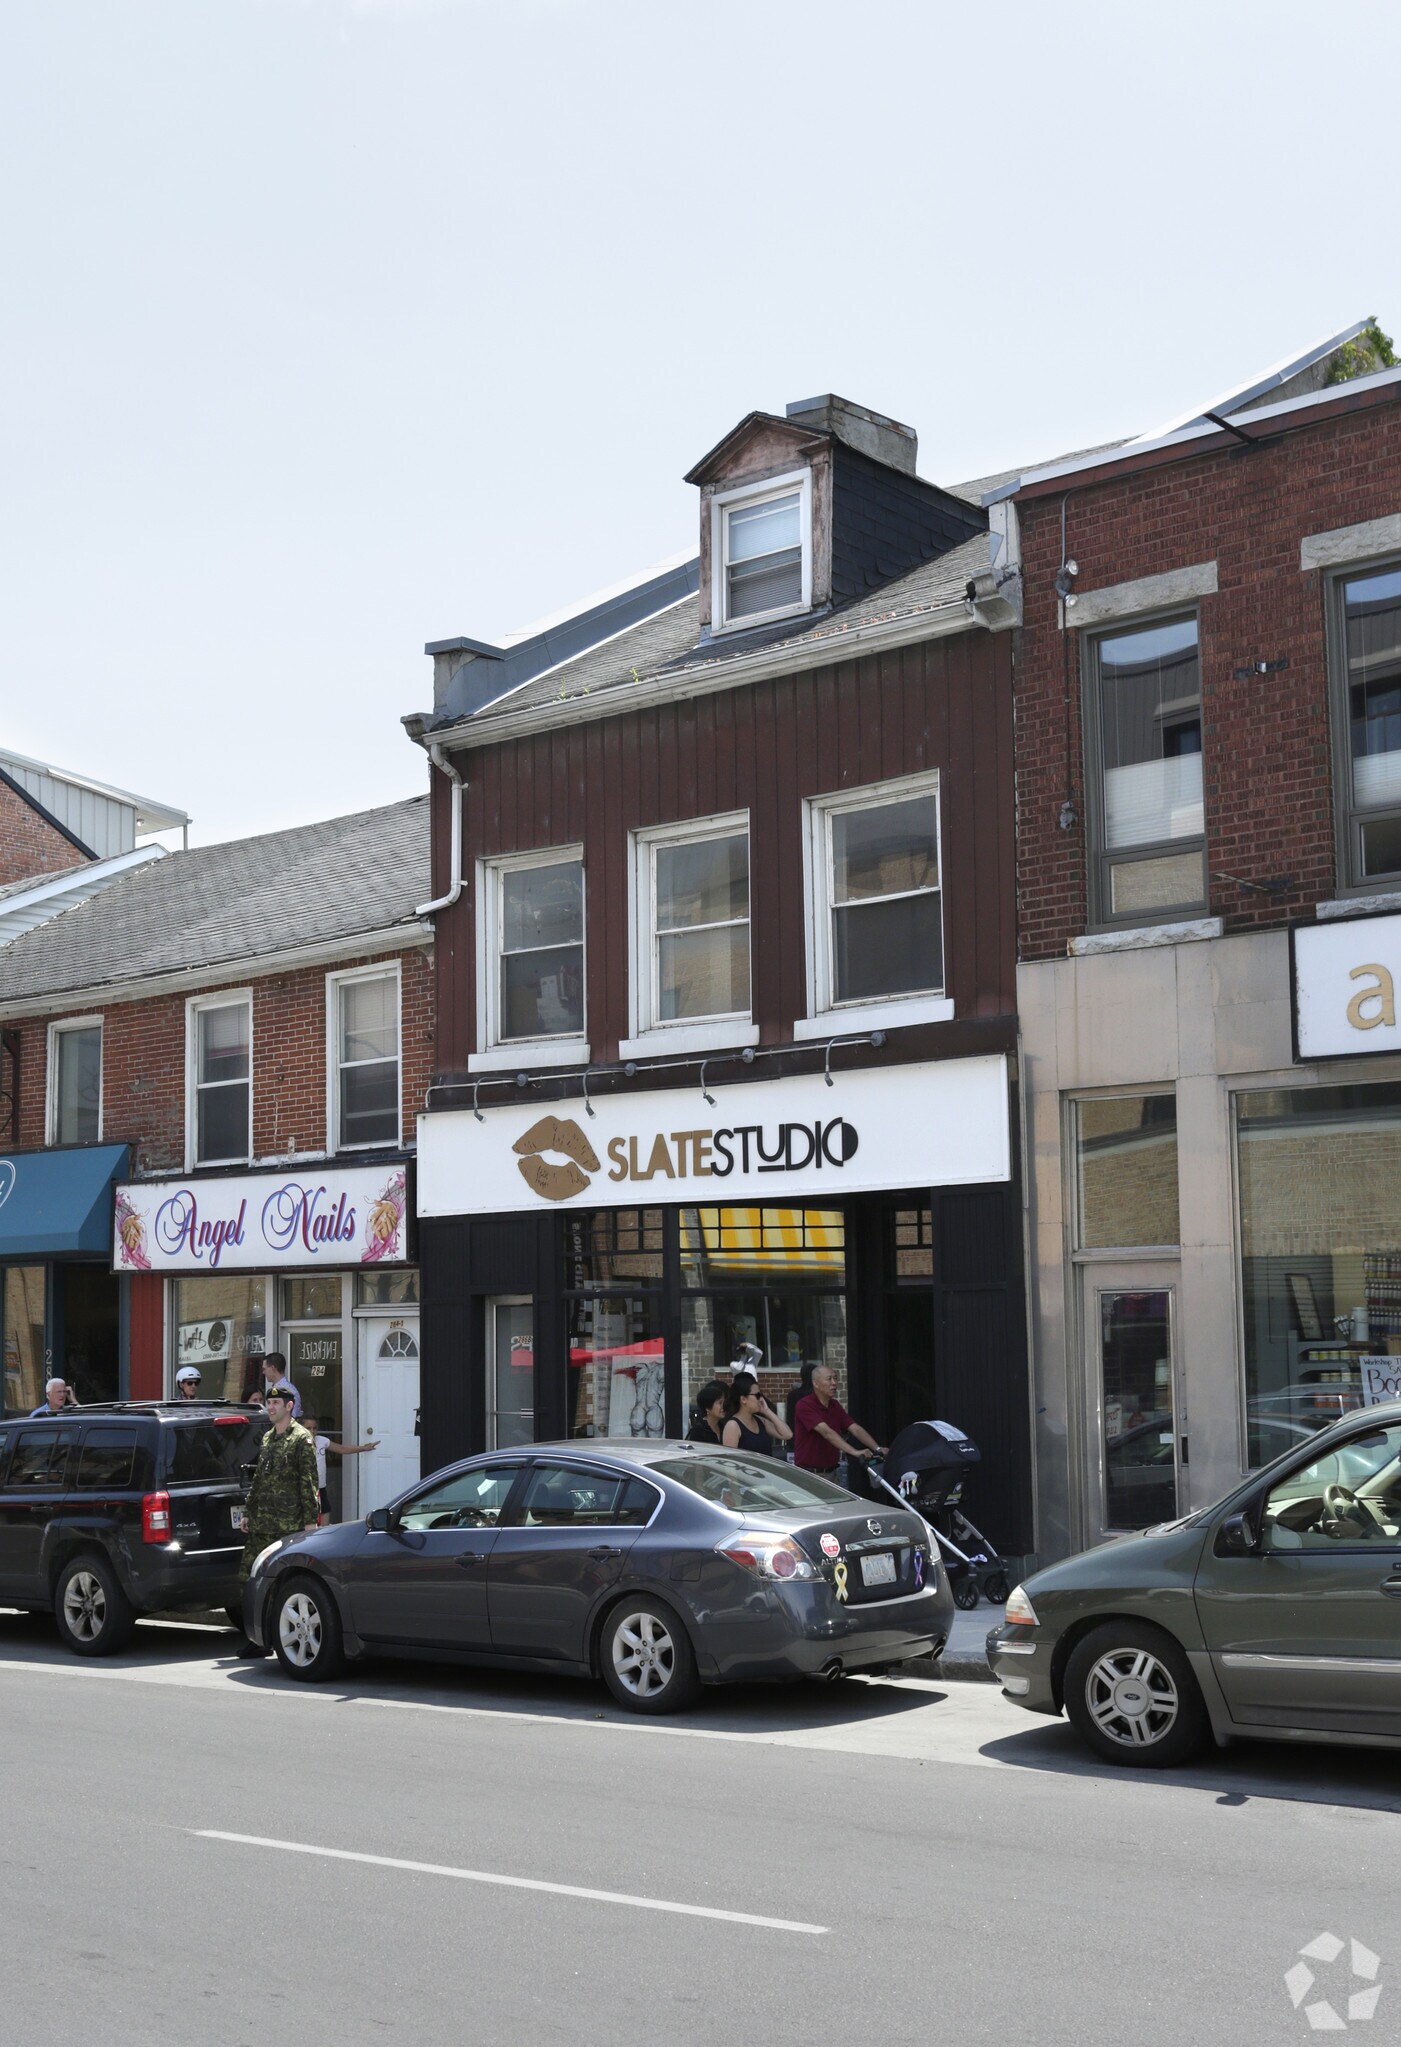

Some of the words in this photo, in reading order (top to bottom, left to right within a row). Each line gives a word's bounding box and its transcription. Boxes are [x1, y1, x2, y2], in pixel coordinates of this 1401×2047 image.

[155, 1189, 247, 1268] Angel
[261, 1182, 356, 1254] Nails
[312, 1366, 325, 1377] 284
